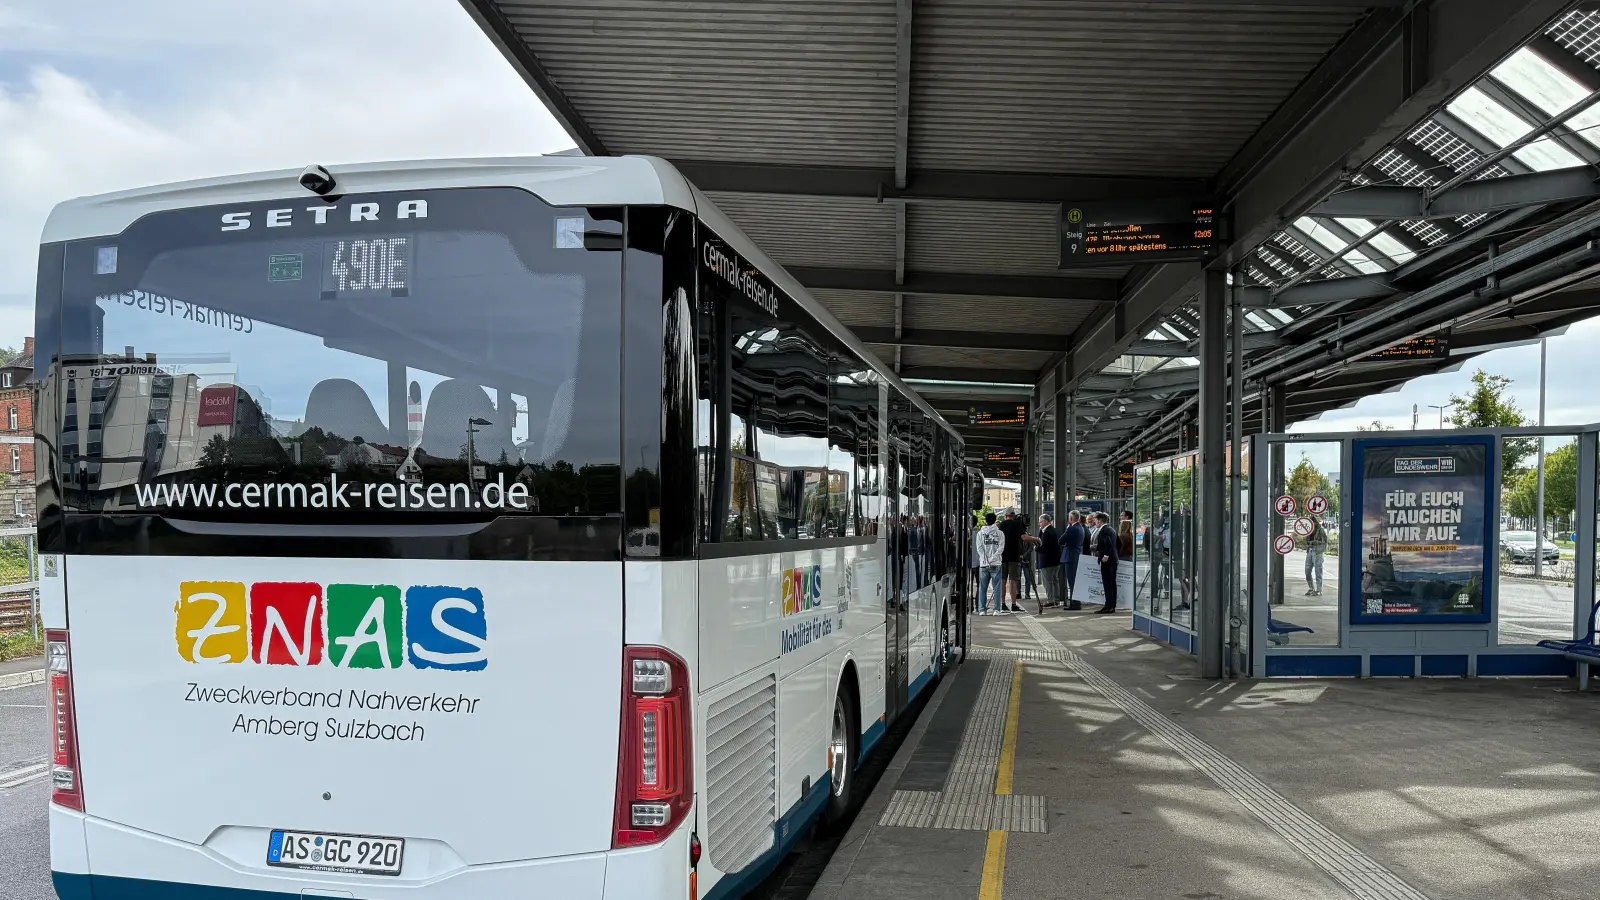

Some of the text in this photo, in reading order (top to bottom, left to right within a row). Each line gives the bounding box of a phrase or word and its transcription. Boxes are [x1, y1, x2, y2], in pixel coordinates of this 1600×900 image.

[221, 200, 429, 232] SETRA
[1066, 231, 1083, 240] Steig
[1071, 243, 1077, 254] 9
[1097, 245, 1109, 253] vor
[1115, 244, 1128, 252] Uhr
[1128, 242, 1167, 253] spätestens
[1194, 229, 1212, 239] 12:05
[332, 238, 406, 291] 490E
[703, 241, 779, 318] cermak-reisen.de
[134, 473, 529, 509] www.cermak-reisen.de
[1385, 489, 1464, 508] FÜR EUCH
[1386, 508, 1462, 525] TAUCHEN
[1387, 525, 1461, 542] WIR AUF.
[782, 568, 822, 617] ZNAS
[182, 588, 488, 670] ZNAS
[781, 614, 833, 656] Mobilität für das
[185, 682, 480, 714] Zweckverband Nahverkehr
[232, 713, 425, 742] Amberg Sulzbach
[281, 835, 310, 860] AS
[323, 838, 352, 863] GC
[357, 841, 398, 867] 920
